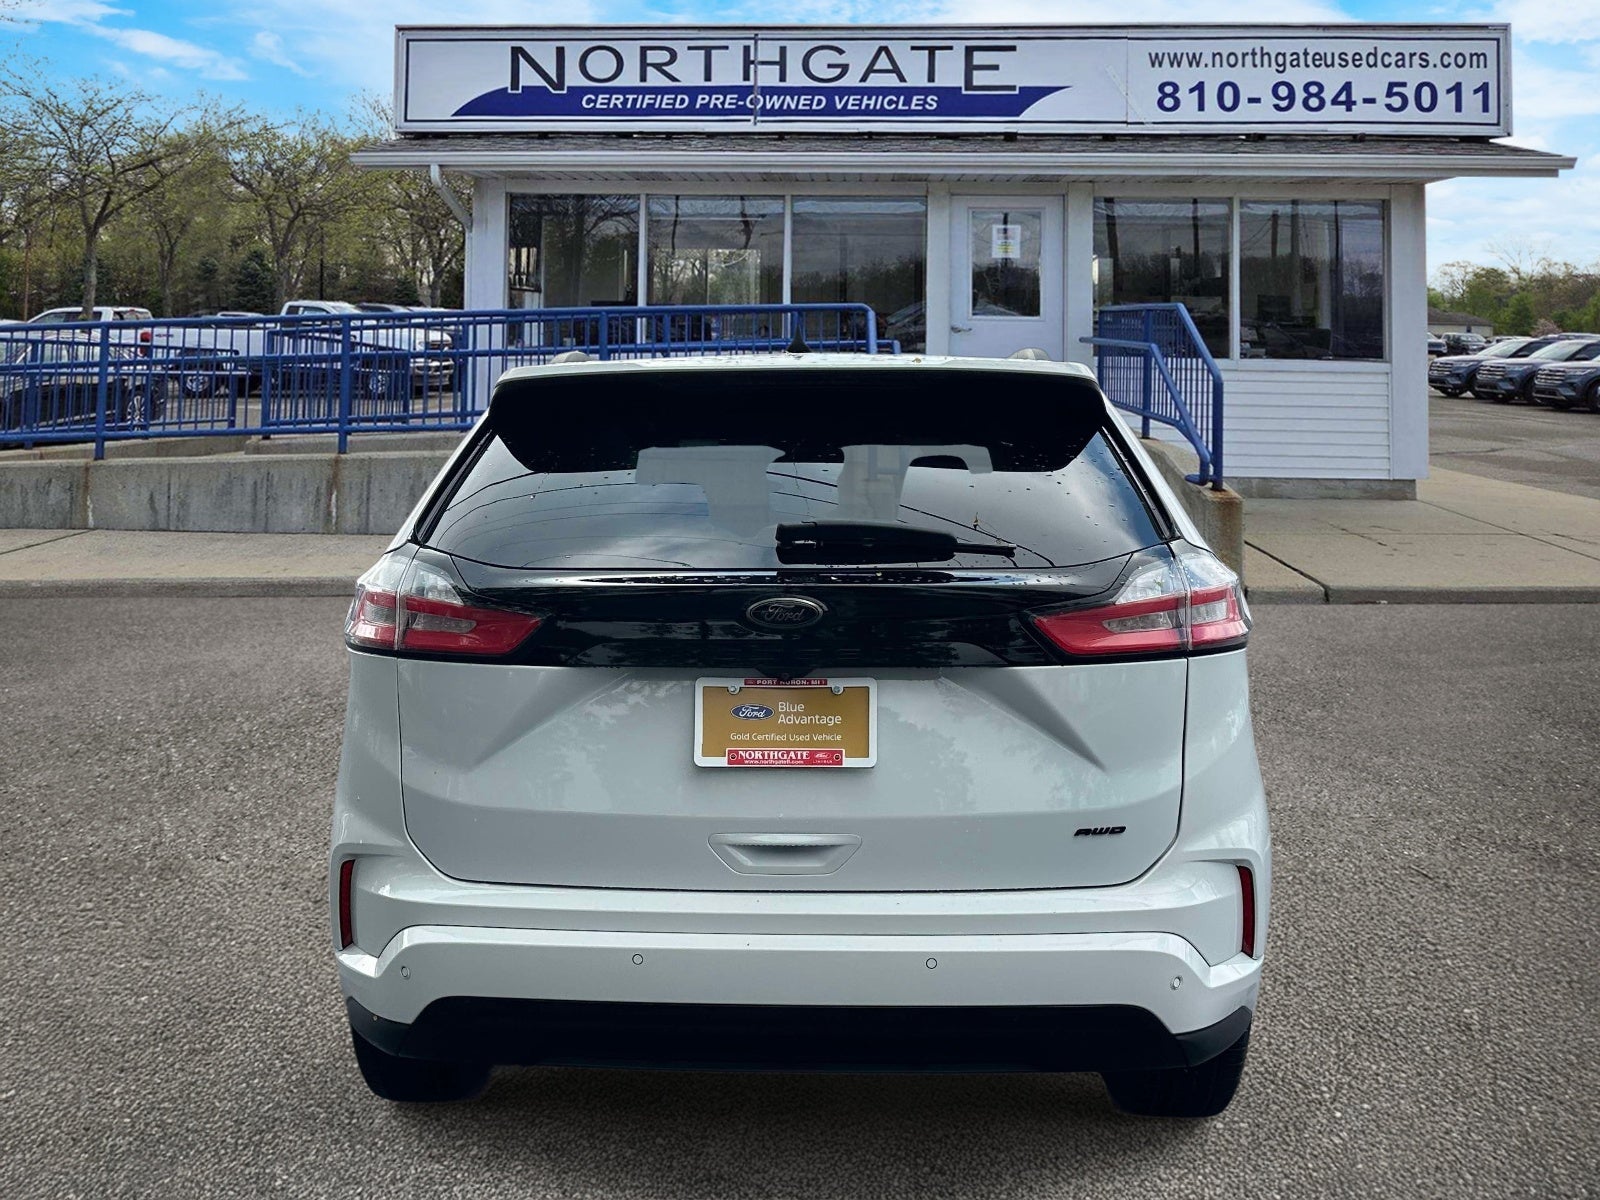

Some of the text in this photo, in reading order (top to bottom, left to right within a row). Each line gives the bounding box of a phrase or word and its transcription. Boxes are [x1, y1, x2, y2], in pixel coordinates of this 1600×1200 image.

[1148, 46, 1488, 73] www.northgateusedcars.com
[509, 45, 1018, 93] NORTHGATE
[581, 94, 939, 111] CERTIFIED PRE-OWNED VEHICLES
[1156, 80, 1491, 114] 810-984-5011
[764, 603, 806, 621] Ford
[739, 705, 767, 718] Ford
[778, 701, 805, 712] Blue
[778, 713, 842, 726] Advantage
[730, 732, 842, 741] Gold Certified Used Vehicle
[738, 750, 810, 760] NORTHGATE
[1074, 825, 1127, 836] AWD
